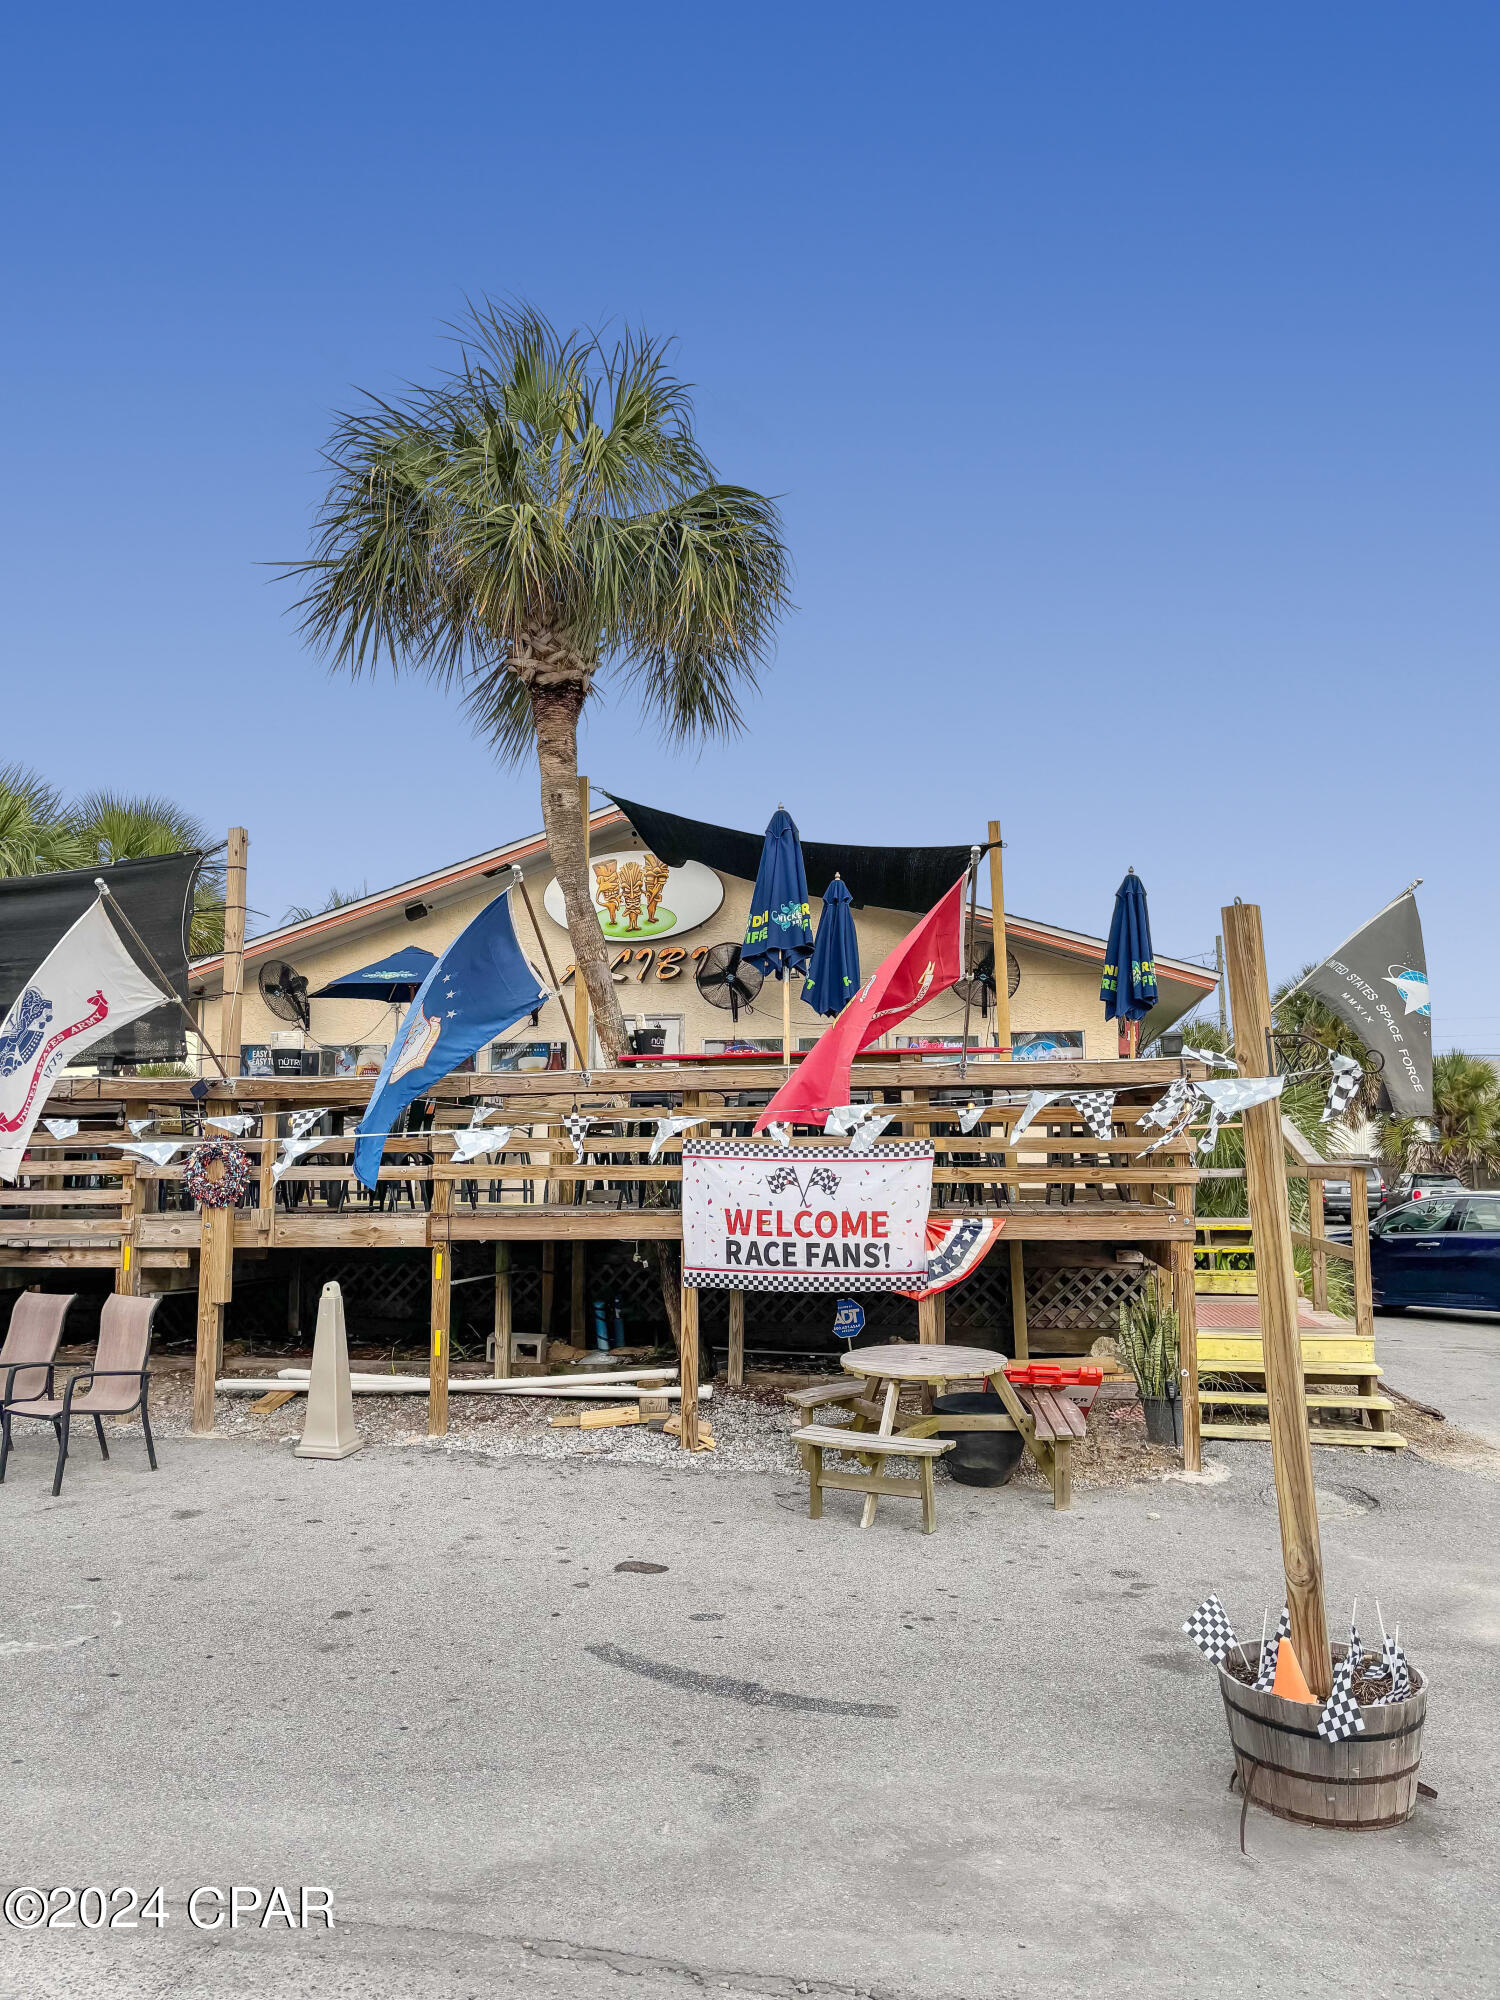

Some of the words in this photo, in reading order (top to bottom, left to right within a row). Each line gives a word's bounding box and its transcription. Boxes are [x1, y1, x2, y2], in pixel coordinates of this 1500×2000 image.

[1325, 958, 1350, 976] UNITED
[1346, 973, 1379, 1001] STATES
[1375, 1003, 1404, 1043] SPACE
[1398, 1048, 1425, 1093] FORCE
[16, 1080, 39, 1125] UNITED
[36, 1033, 66, 1075] STATES
[70, 1011, 104, 1035] ARMY
[42, 1050, 64, 1079] 1775
[252, 1050, 268, 1058] EASY
[252, 1057, 268, 1066] EASY
[724, 1208, 890, 1238] WELCOME
[725, 1239, 798, 1267] RACE
[805, 1242, 891, 1269] FANS!
[834, 1308, 860, 1325] ADT
